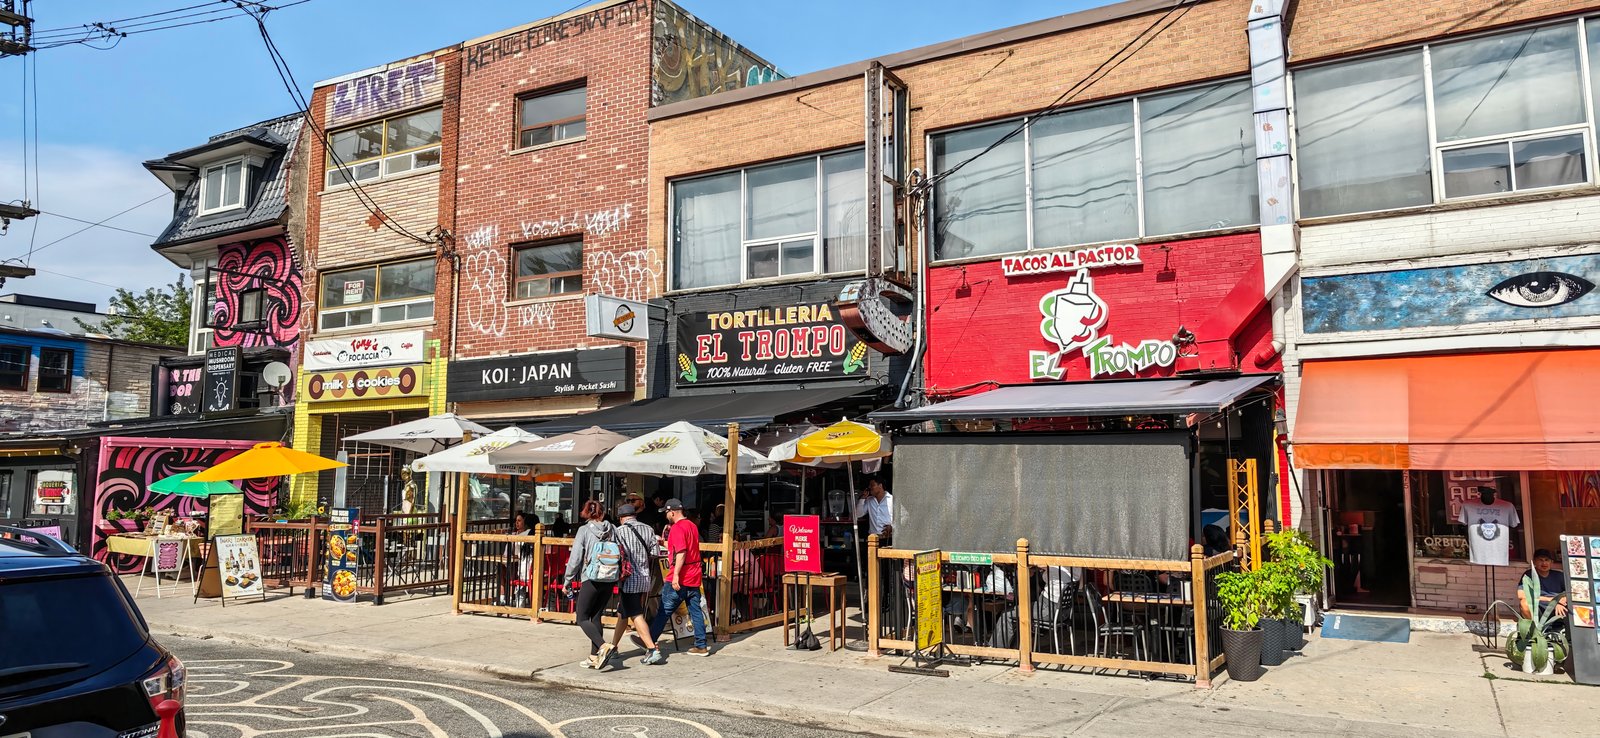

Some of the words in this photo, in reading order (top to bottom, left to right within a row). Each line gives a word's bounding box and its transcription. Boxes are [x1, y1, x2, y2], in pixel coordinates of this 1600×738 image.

[1004, 256, 1047, 273] TACOS
[1051, 252, 1074, 267] AL
[1078, 246, 1135, 266] PASTOR
[708, 303, 833, 330] TORTILLERIA
[696, 333, 727, 364] EL
[739, 325, 847, 361] TROMPO
[209, 350, 235, 358] MEDICAL
[348, 352, 379, 362] FOCACCIA
[1032, 352, 1061, 377] EL
[1087, 337, 1174, 375] TROMPO
[208, 363, 235, 371] DISPENSARY
[519, 362, 572, 384] JAPAN
[706, 367, 731, 379] 100%
[732, 364, 767, 377] Natural
[774, 364, 803, 374] Gluten
[806, 361, 832, 373] FREE
[322, 380, 343, 390] milk
[346, 379, 354, 389] &
[357, 375, 400, 387] cookies
[554, 385, 575, 393] Stylish
[577, 383, 598, 391] Pocket
[599, 381, 616, 390] Sushi
[1424, 537, 1469, 548] ORBITA
[120, 724, 160, 738] TITANIU
